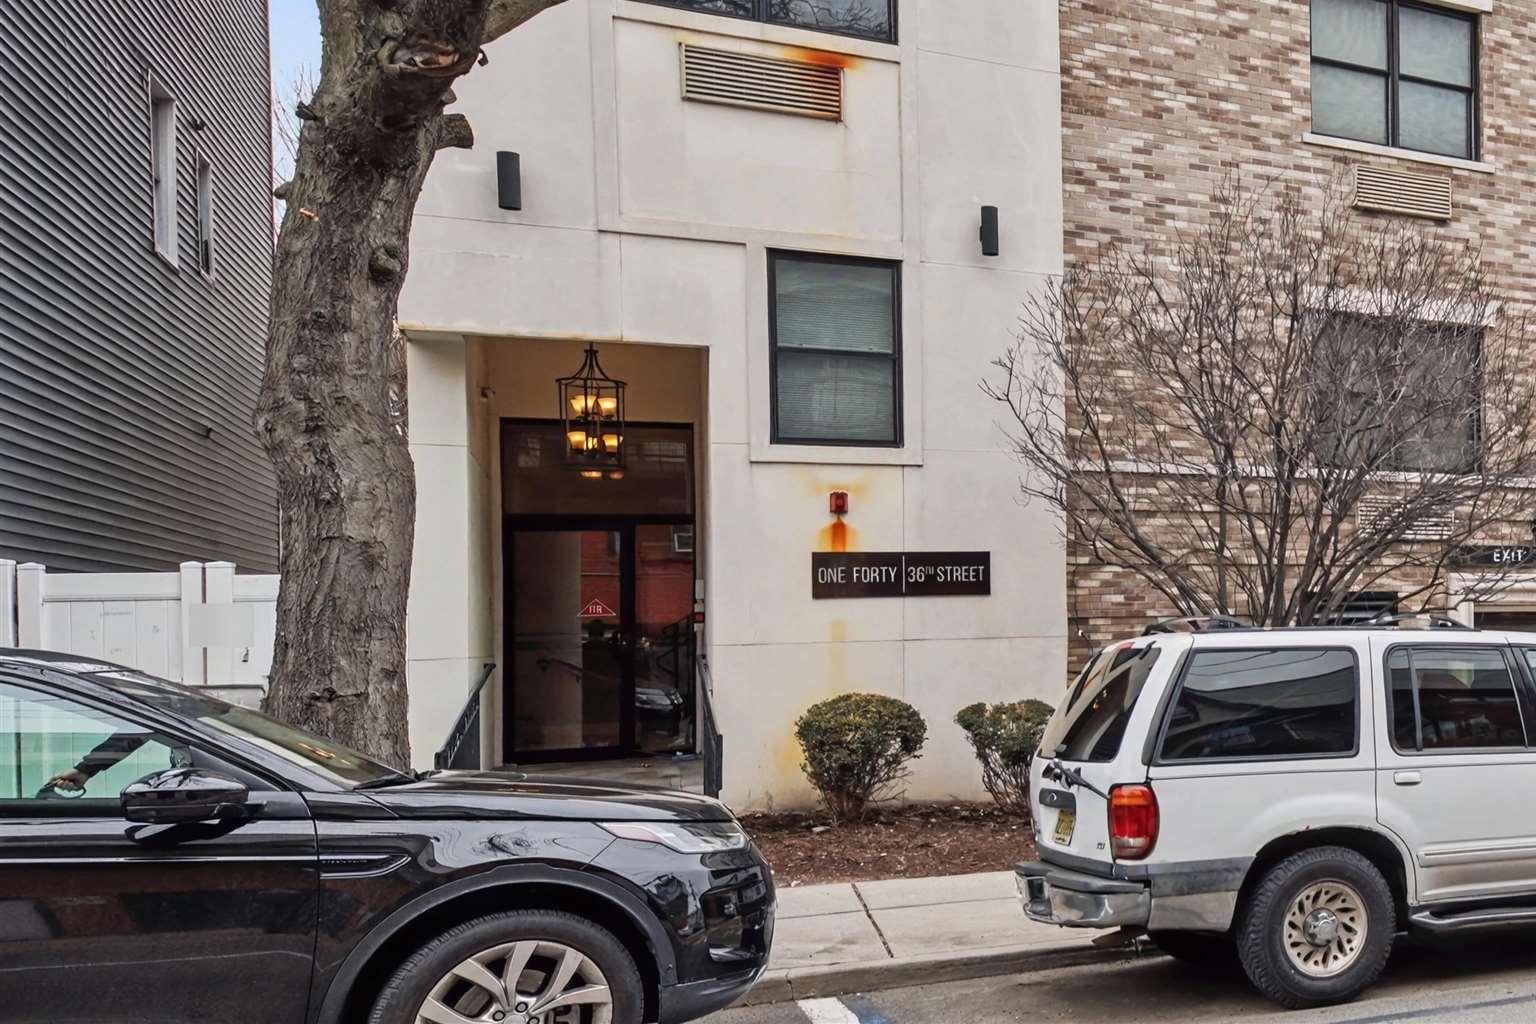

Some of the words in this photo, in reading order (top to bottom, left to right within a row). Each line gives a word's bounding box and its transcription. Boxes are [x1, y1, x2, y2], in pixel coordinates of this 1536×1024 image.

[1493, 549, 1523, 562] EXIT
[818, 567, 847, 584] ONE
[853, 566, 897, 583] FORTY
[936, 566, 985, 582] STREET
